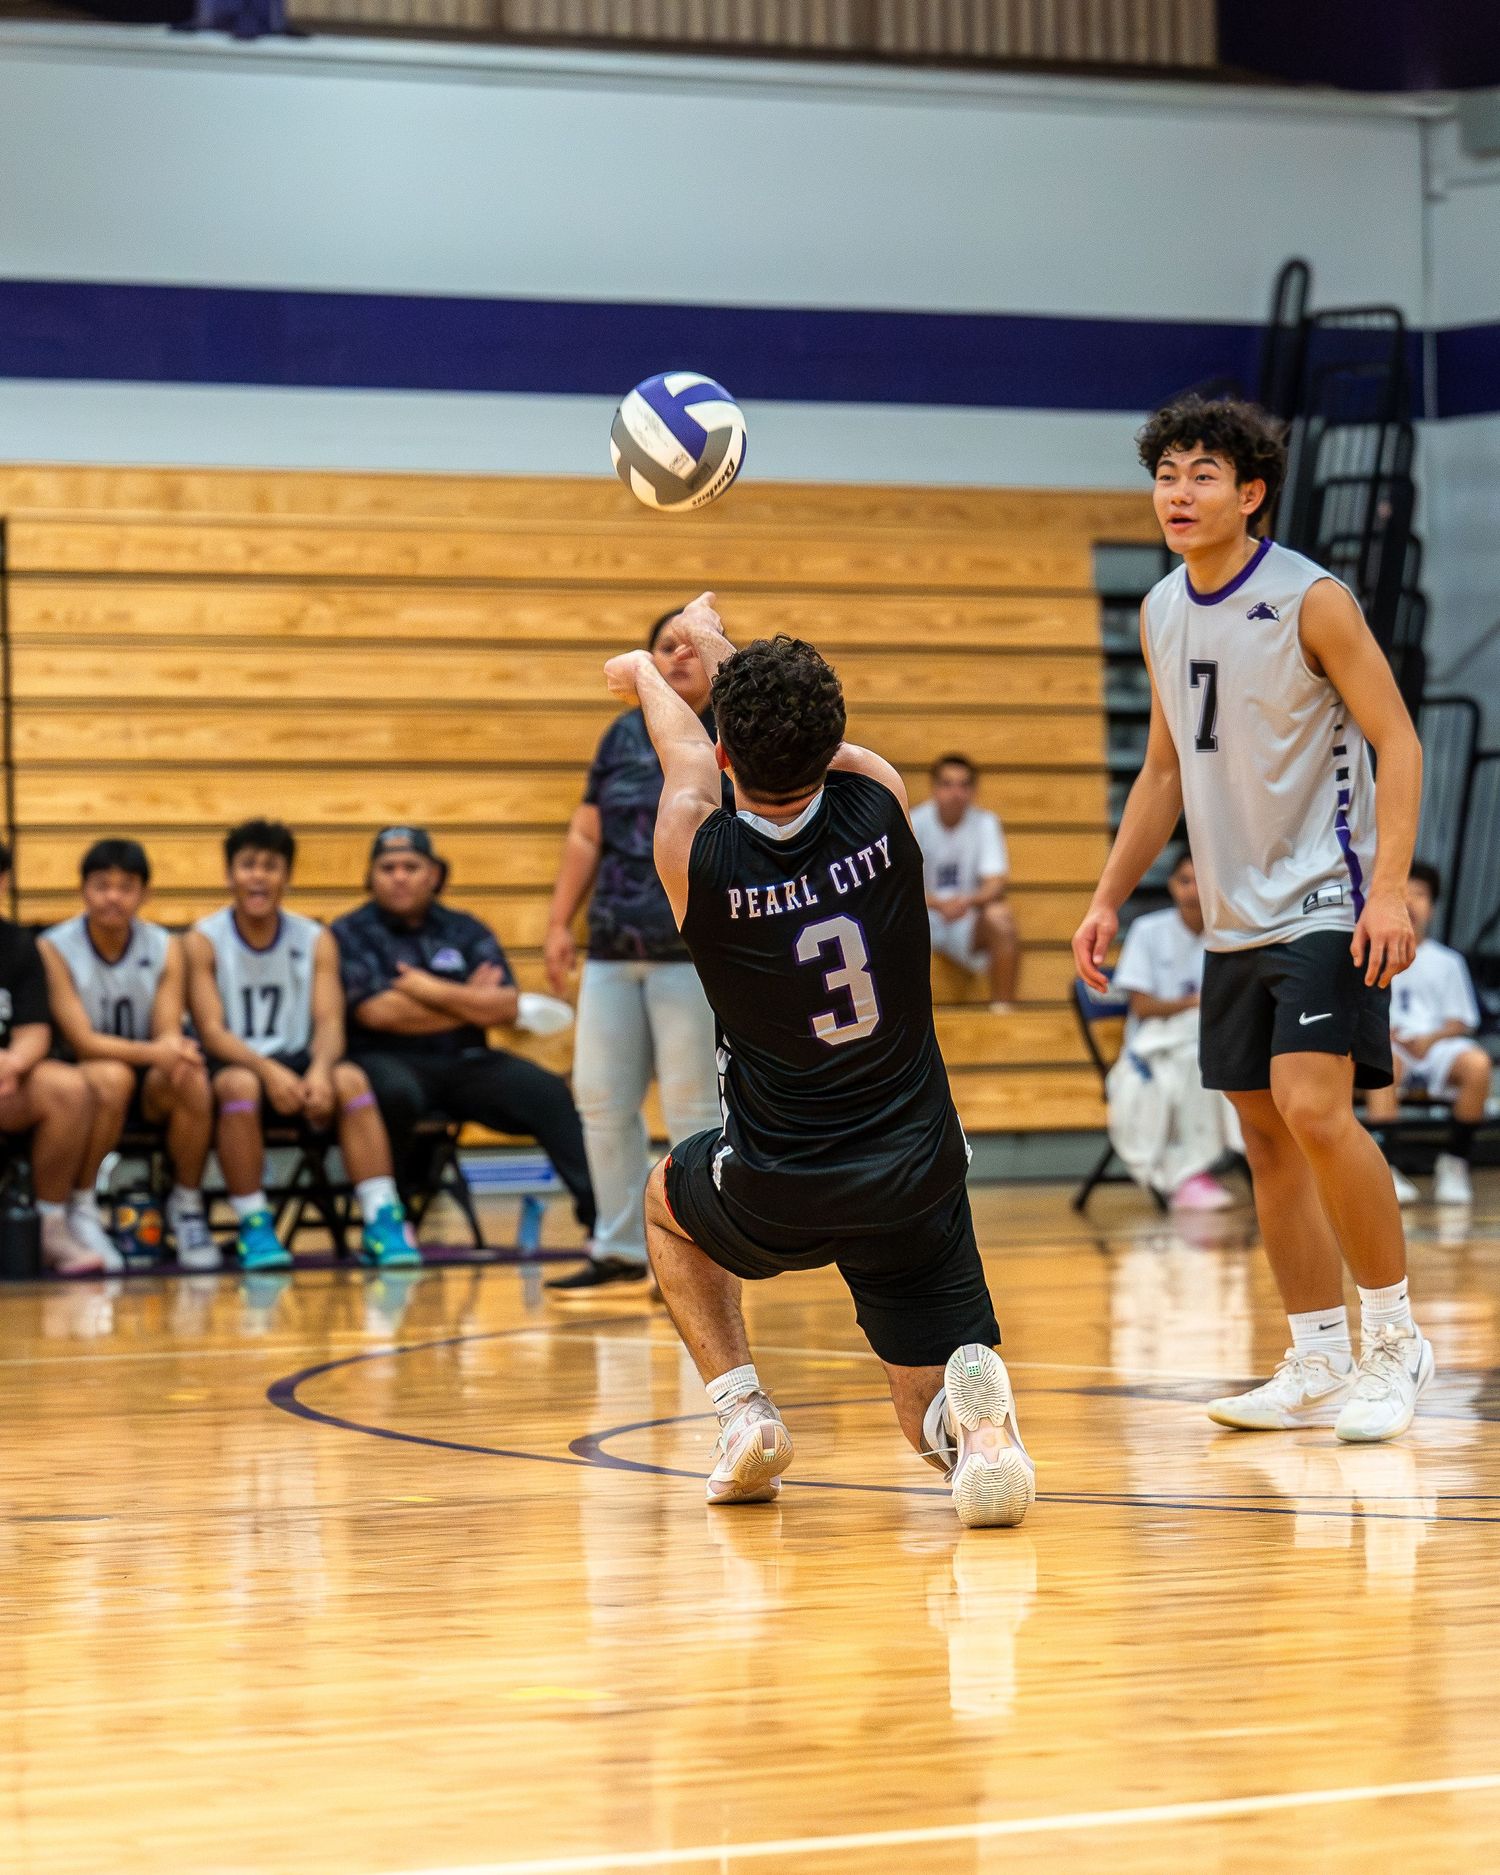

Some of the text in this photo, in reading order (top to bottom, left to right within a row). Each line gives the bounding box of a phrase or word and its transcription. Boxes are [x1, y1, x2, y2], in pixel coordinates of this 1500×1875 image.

[1189, 658, 1218, 752] 7
[728, 875, 818, 918] PEARL
[829, 835, 891, 895] CITY
[241, 985, 282, 1038] 17
[795, 914, 881, 1047] 3
